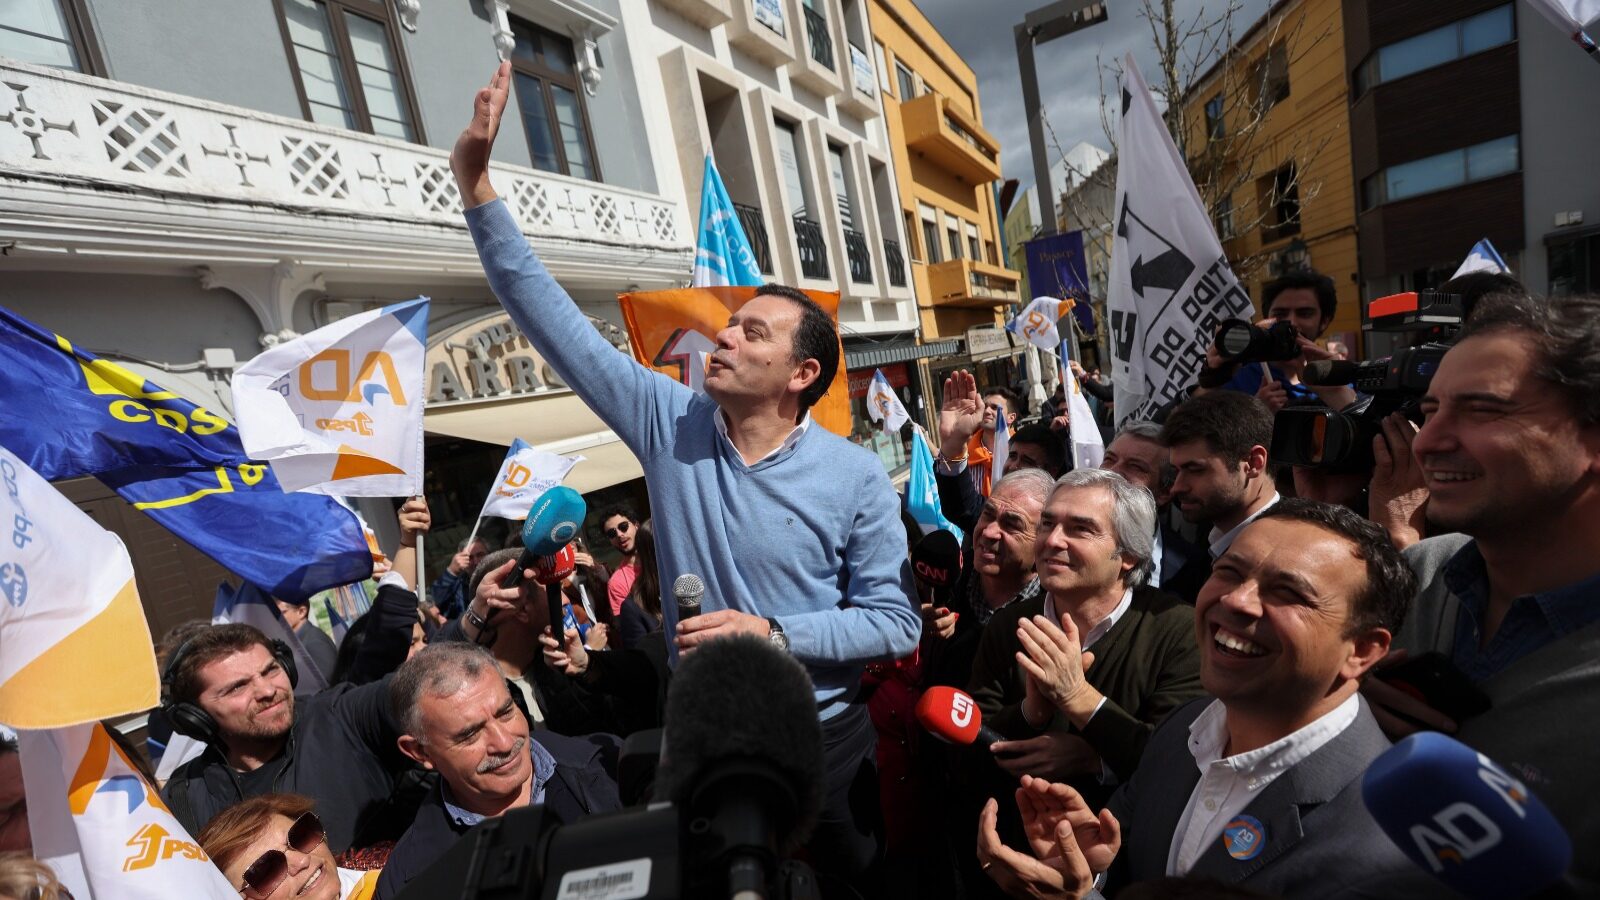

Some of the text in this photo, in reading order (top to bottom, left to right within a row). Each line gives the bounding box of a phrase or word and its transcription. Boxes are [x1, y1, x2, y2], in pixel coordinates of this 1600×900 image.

[108, 399, 229, 436] CDS
[916, 561, 947, 582] CNN
[1409, 802, 1503, 872] AD
